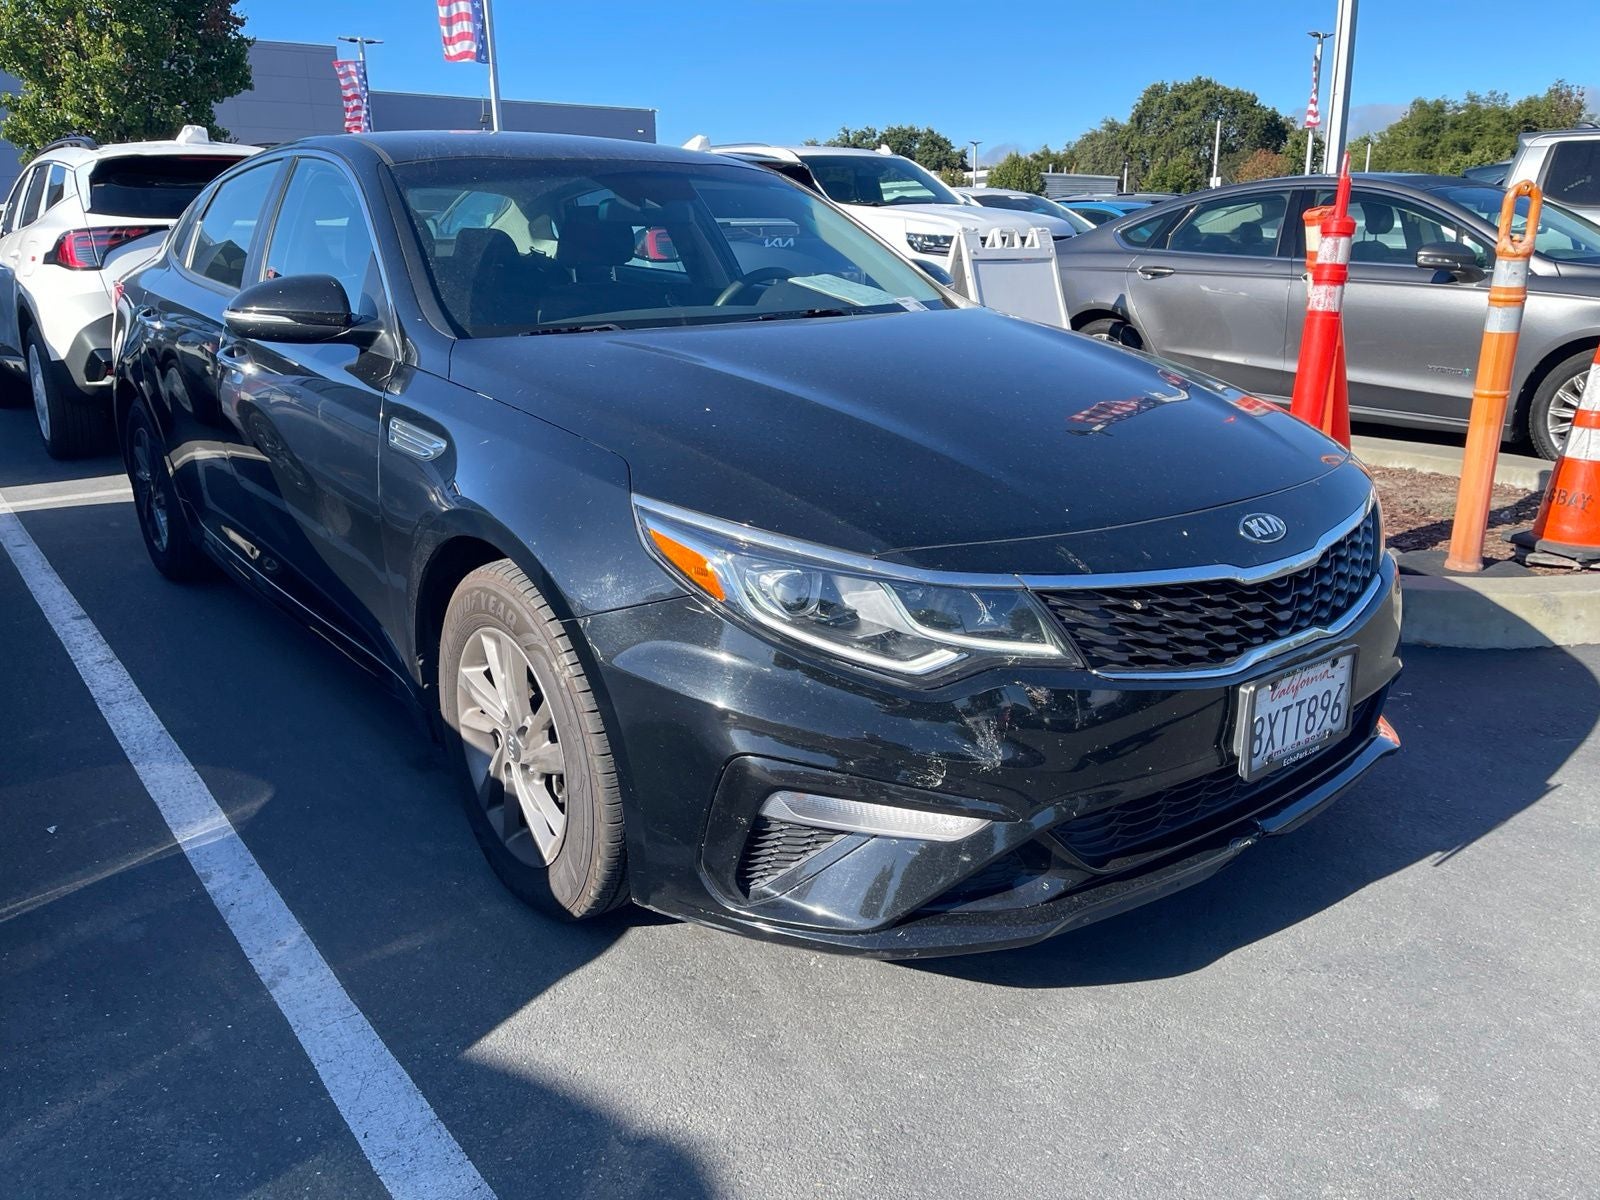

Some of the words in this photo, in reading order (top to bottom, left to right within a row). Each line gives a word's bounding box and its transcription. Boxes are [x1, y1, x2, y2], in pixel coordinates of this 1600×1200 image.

[1244, 516, 1283, 538] KIA
[1270, 669, 1335, 702] California
[1253, 683, 1345, 759] 8XTT896
[1282, 744, 1320, 767] EchoPark.com
